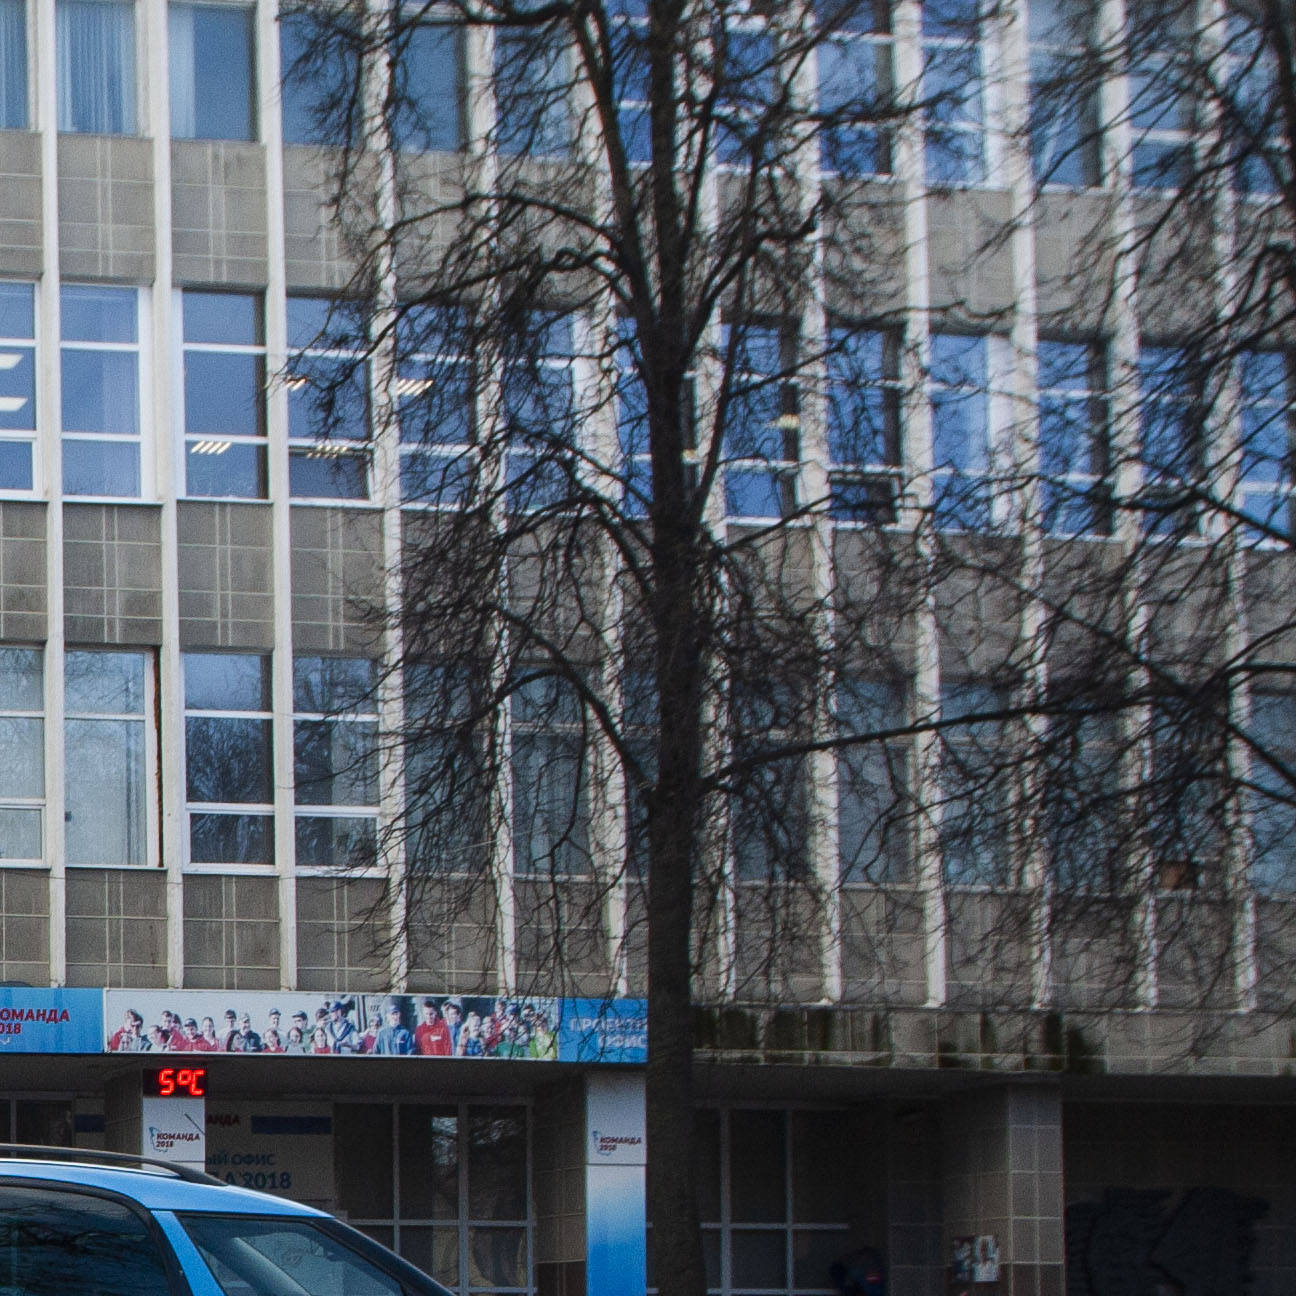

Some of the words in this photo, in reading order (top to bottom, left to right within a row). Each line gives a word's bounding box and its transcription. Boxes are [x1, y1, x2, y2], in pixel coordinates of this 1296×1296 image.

[156, 1132, 201, 1143] КОМАНДА
[599, 1136, 642, 1146] КОМАНДА
[156, 1140, 174, 1148] 2018
[231, 1153, 277, 1166] ОФИС
[241, 1171, 292, 1190] 2018
